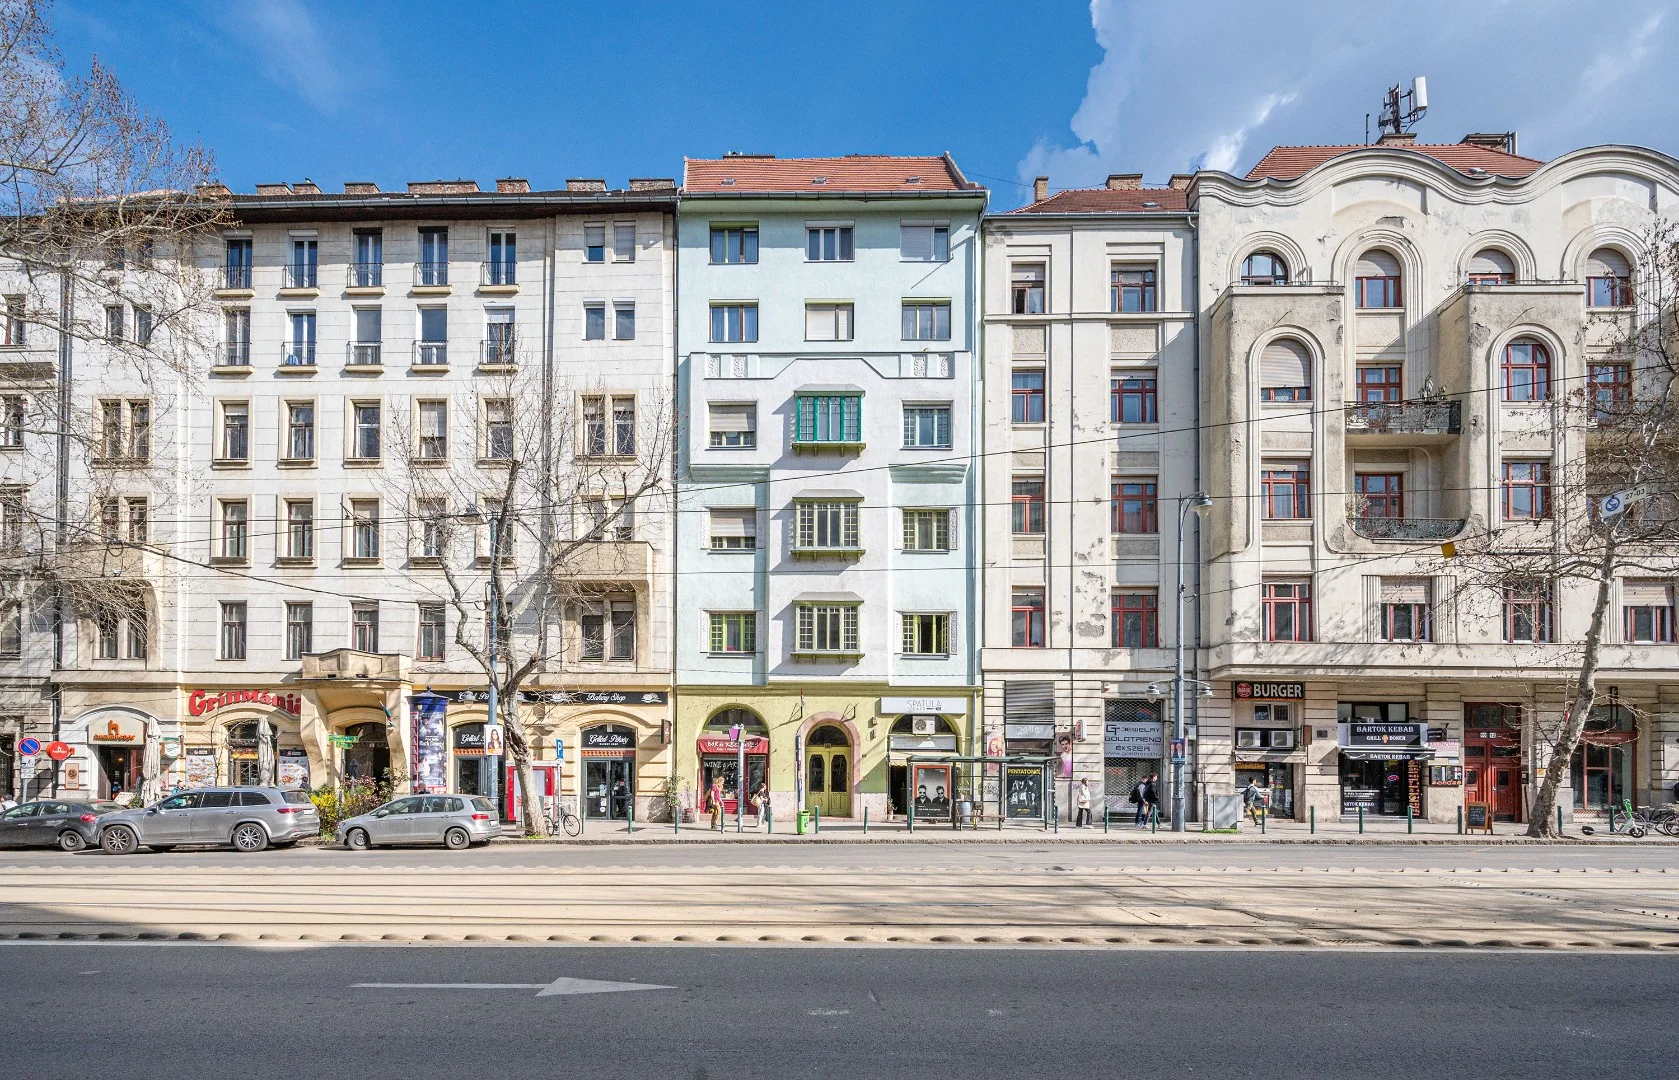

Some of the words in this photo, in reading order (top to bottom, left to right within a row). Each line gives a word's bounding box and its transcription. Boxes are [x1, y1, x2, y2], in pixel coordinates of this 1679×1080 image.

[1625, 489, 1645, 500] 27-03
[1253, 683, 1302, 698] BURGER
[586, 693, 609, 703] Bakery
[610, 692, 626, 703] Shop
[907, 699, 942, 708] SPATULA
[557, 741, 563, 756] P
[704, 761, 721, 769] WINE
